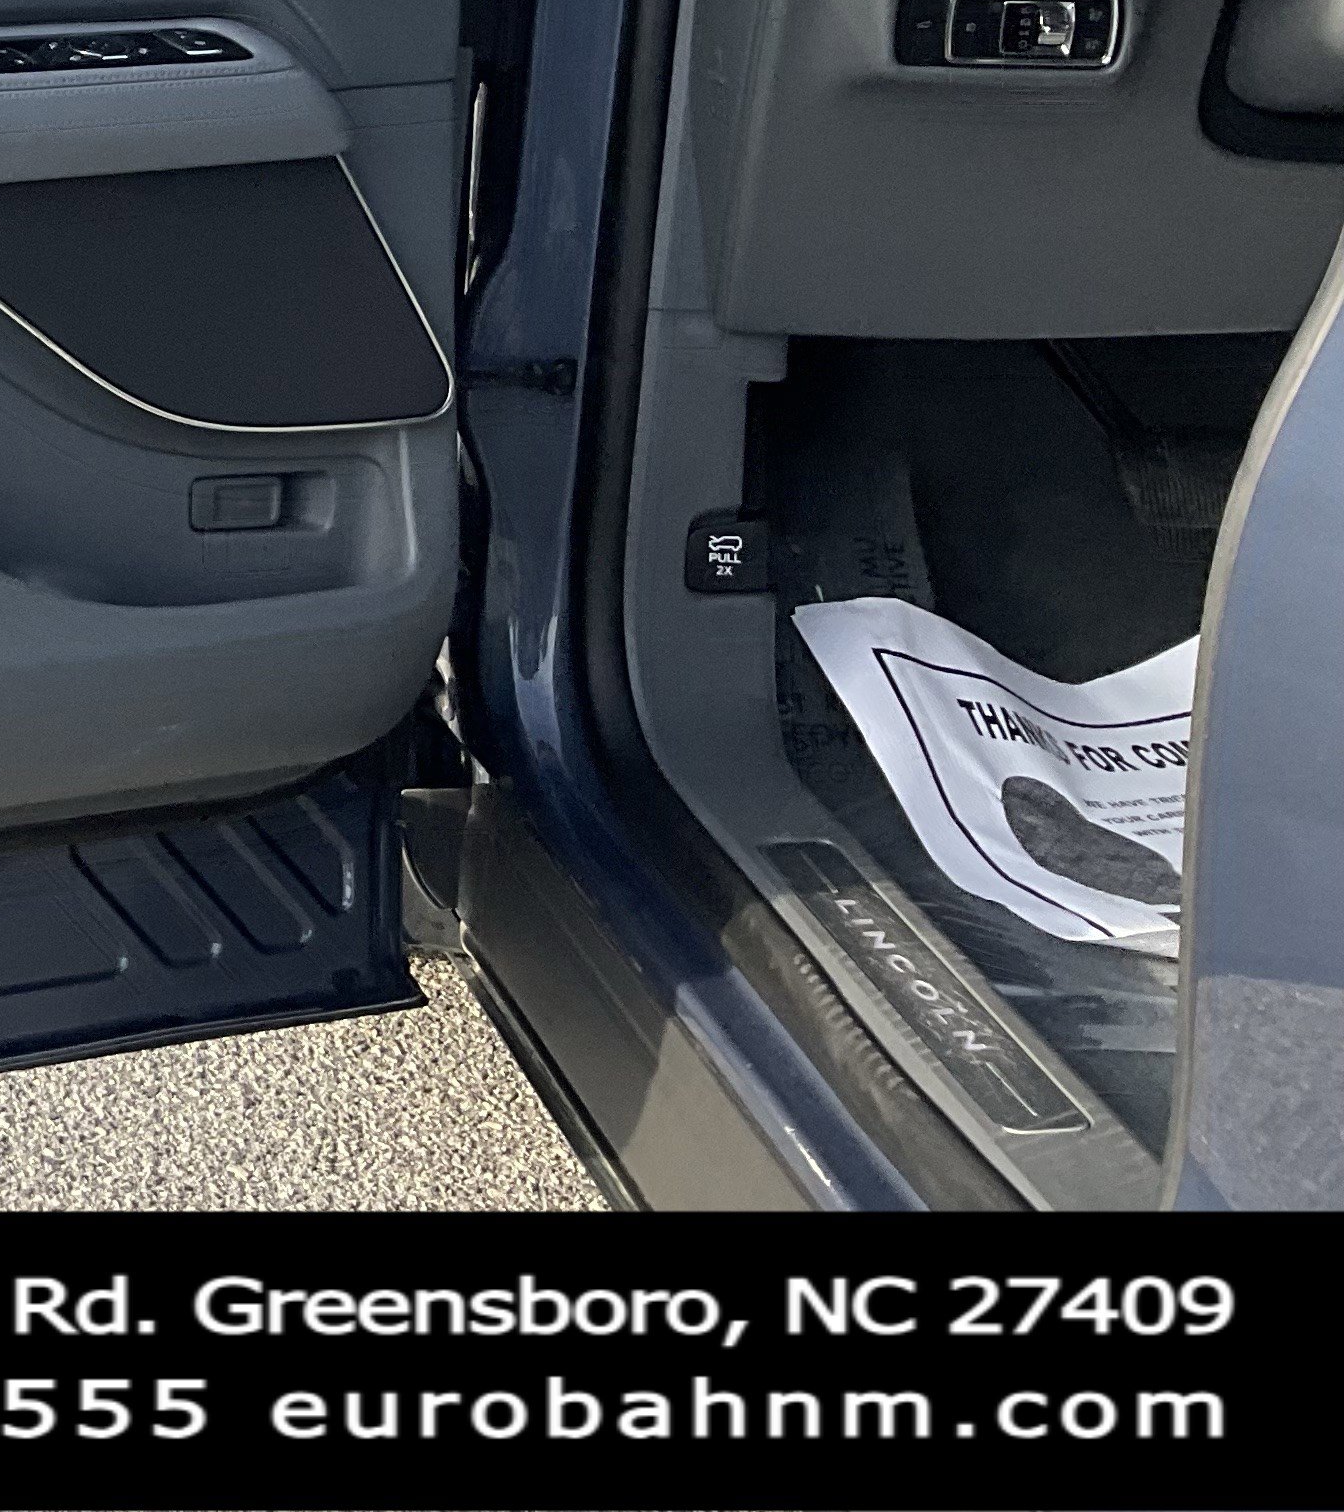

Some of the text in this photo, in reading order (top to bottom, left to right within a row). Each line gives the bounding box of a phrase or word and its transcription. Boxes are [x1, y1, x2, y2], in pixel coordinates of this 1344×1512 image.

[708, 552, 742, 564] PULL
[716, 564, 733, 576] 2X
[956, 698, 1071, 766] THANKS
[1065, 740, 1141, 772] FOR
[1100, 815, 1146, 825] YOUR
[834, 899, 986, 1050] LINCOLN
